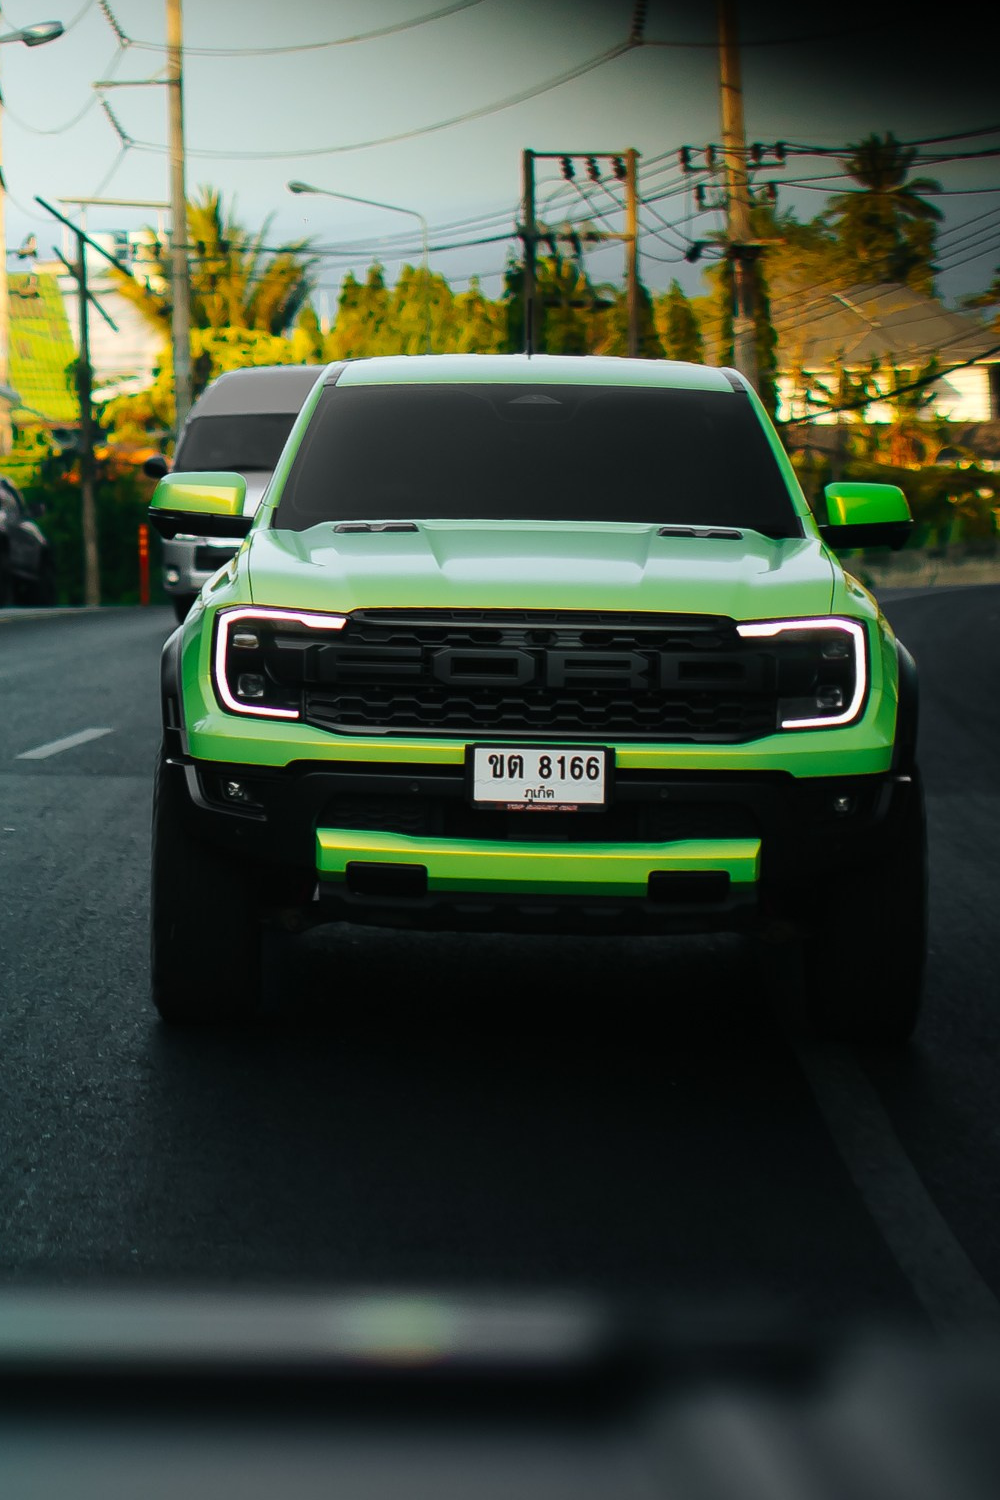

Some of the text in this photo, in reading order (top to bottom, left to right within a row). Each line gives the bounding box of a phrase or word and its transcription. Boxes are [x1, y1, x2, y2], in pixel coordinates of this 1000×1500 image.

[318, 643, 770, 693] FORD
[488, 754, 600, 780] ขต 8166
